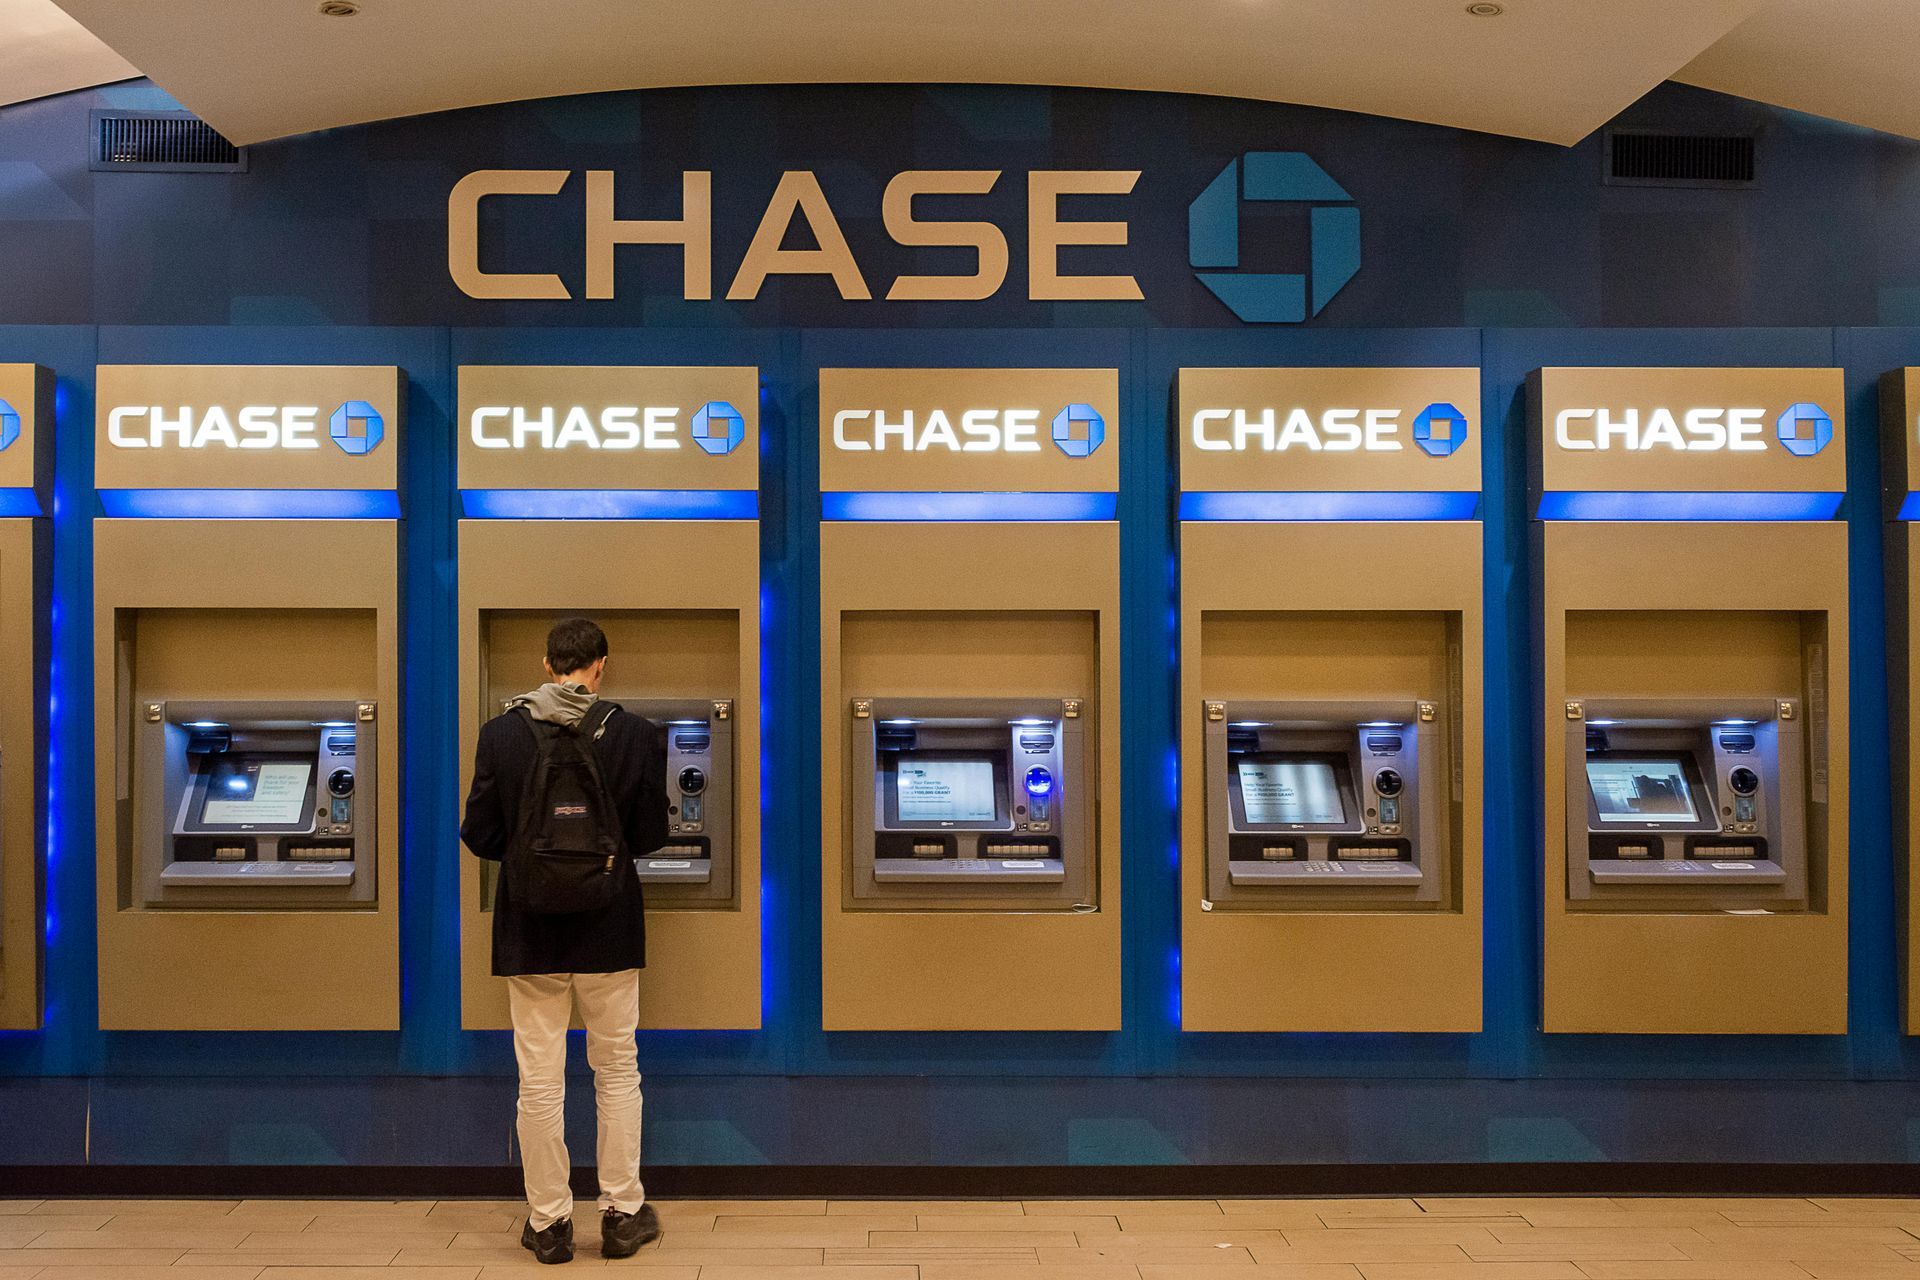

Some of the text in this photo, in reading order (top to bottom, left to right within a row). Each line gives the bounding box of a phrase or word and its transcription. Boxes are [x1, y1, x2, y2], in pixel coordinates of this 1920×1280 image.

[448, 169, 1145, 300] CHASE
[107, 404, 320, 450] CHASE
[470, 405, 681, 450] CHASE
[832, 408, 1042, 452] CHASE
[1191, 407, 1403, 452] CHASE
[1554, 407, 1768, 452] CHASE
